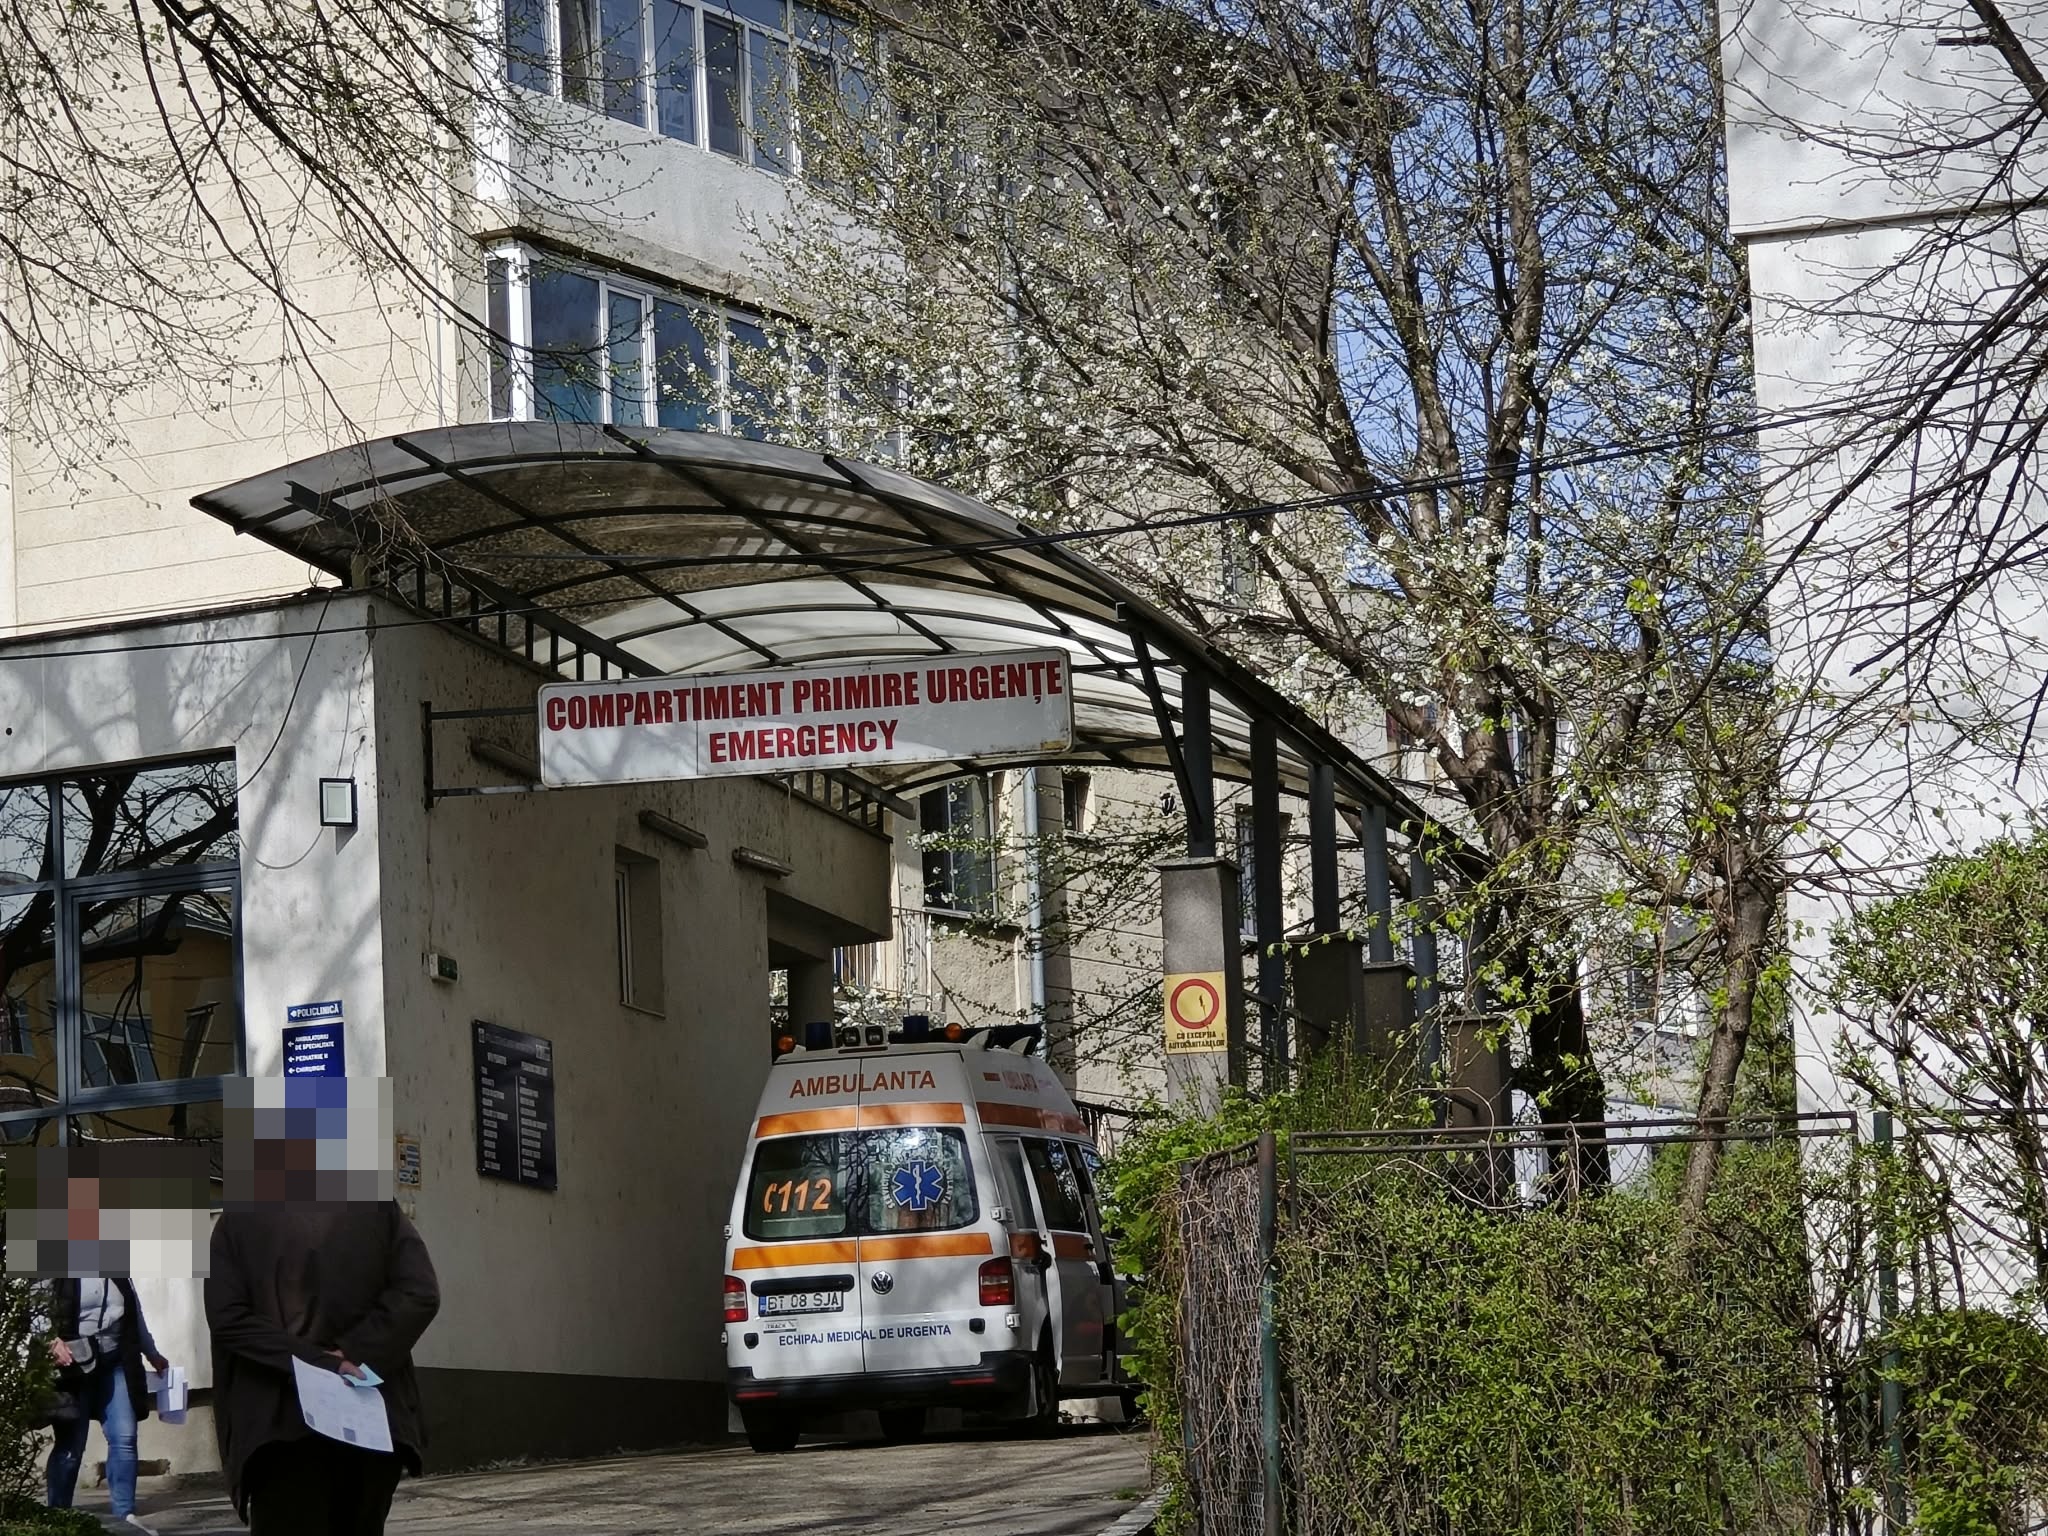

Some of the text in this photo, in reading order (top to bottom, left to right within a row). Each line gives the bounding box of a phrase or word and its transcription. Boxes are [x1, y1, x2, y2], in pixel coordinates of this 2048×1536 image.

[545, 660, 1063, 730] COMPARTIMENT PRIMIRE URGENȚE
[709, 719, 898, 763] EMERGENCY
[789, 1070, 936, 1098] AMBULANTA
[777, 1179, 832, 1212] 112
[767, 1296, 785, 1310] BT
[791, 1294, 808, 1308] 08
[813, 1292, 839, 1308] SJA
[779, 1325, 952, 1346] ECHIPAJ MEDICAL DE URGENTA
